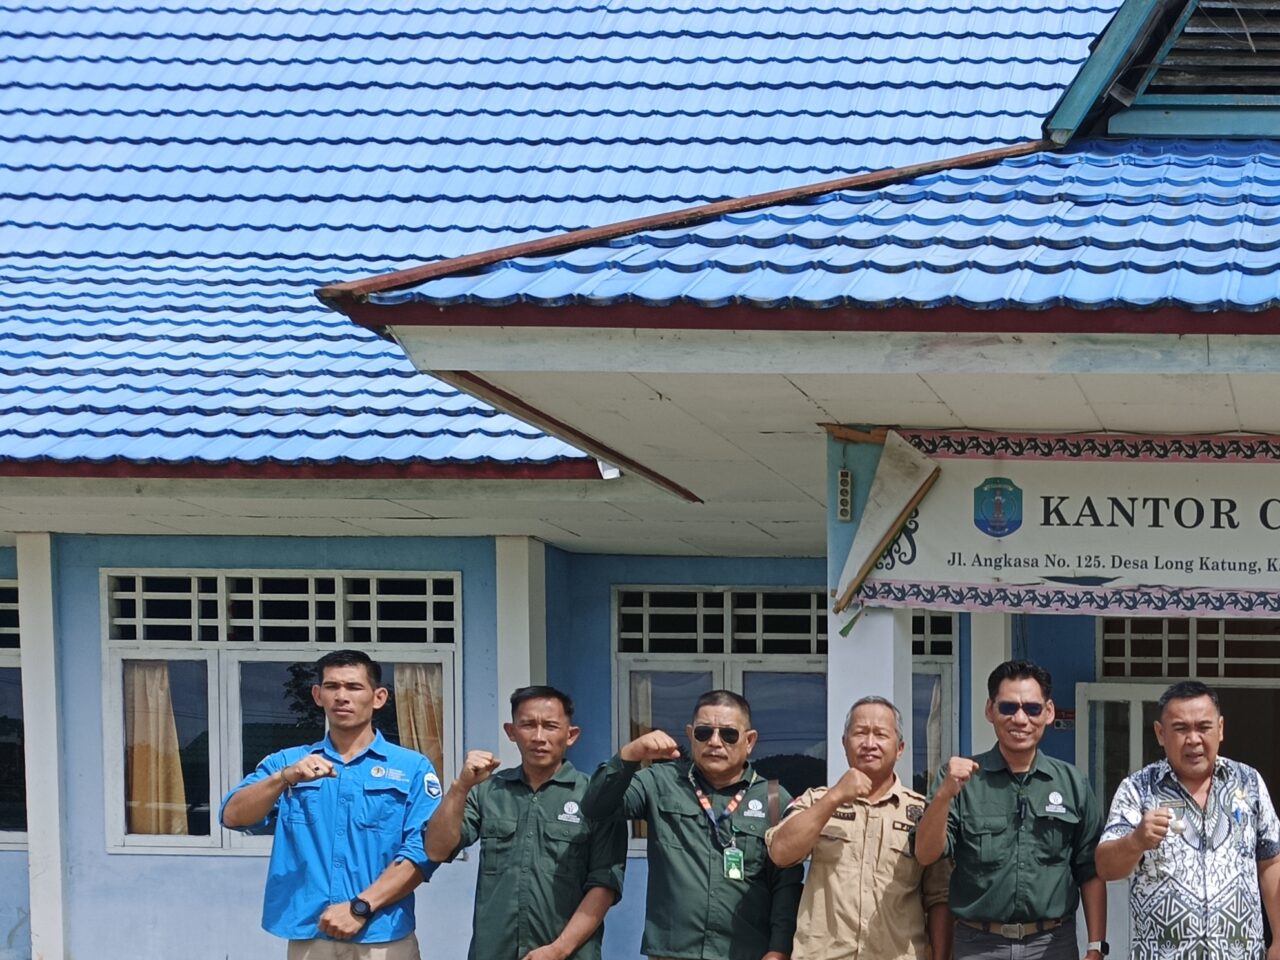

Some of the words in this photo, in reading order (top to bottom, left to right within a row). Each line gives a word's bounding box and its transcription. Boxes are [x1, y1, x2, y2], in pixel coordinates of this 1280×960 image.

[1039, 495, 1240, 530] KANTOR
[947, 551, 967, 567] Jl.
[971, 552, 1040, 571] Angkasa
[1044, 553, 1070, 568] No.
[1076, 554, 1106, 569] 125.
[1110, 554, 1149, 570] Desa
[1154, 555, 1194, 574] Long
[1199, 556, 1262, 575] Katung,
